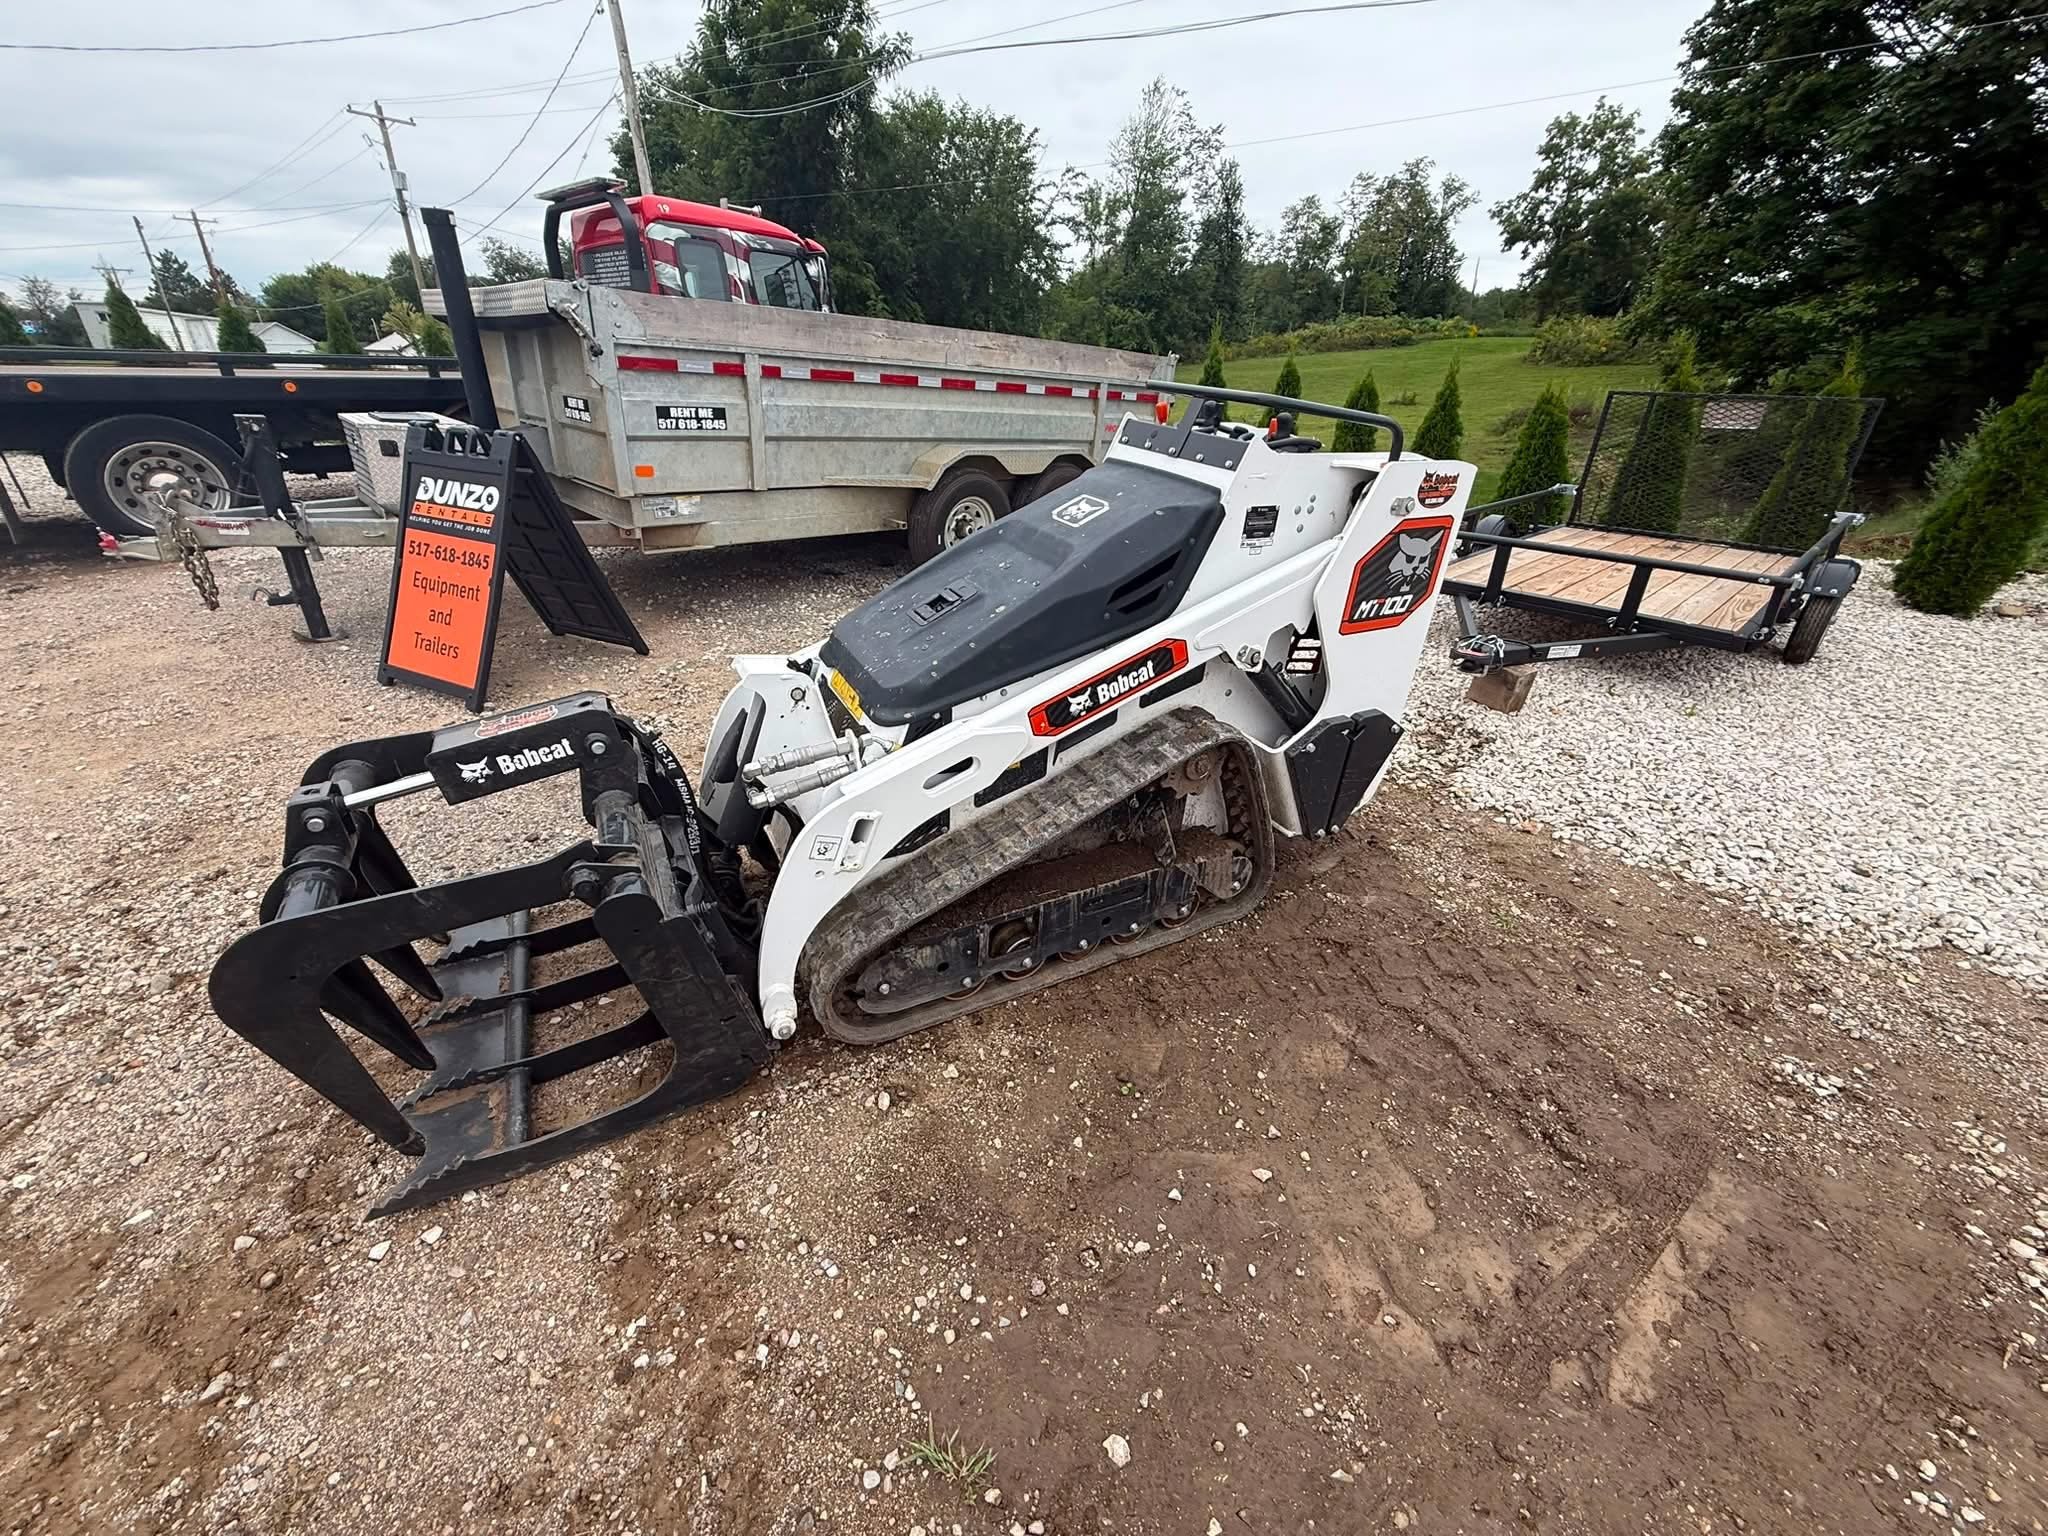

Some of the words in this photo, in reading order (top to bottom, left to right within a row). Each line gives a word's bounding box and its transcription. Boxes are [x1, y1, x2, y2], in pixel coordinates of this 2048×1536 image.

[656, 203, 670, 213] 19
[658, 418, 676, 430] 517
[678, 418, 727, 430] 618-1845
[670, 407, 696, 418] RENT
[698, 408, 714, 419] ME
[415, 476, 500, 513] DUNZO
[409, 515, 431, 524] HELPING
[476, 527, 491, 535] DONE
[414, 503, 492, 525] RENTALS
[408, 540, 490, 570] 517-618-1845
[413, 571, 480, 602] Equipment
[428, 608, 453, 626] and
[1353, 594, 1413, 620] MT100
[414, 632, 460, 659] Trailers
[1096, 659, 1156, 704] Bobcat
[495, 738, 575, 775] Bobcat
